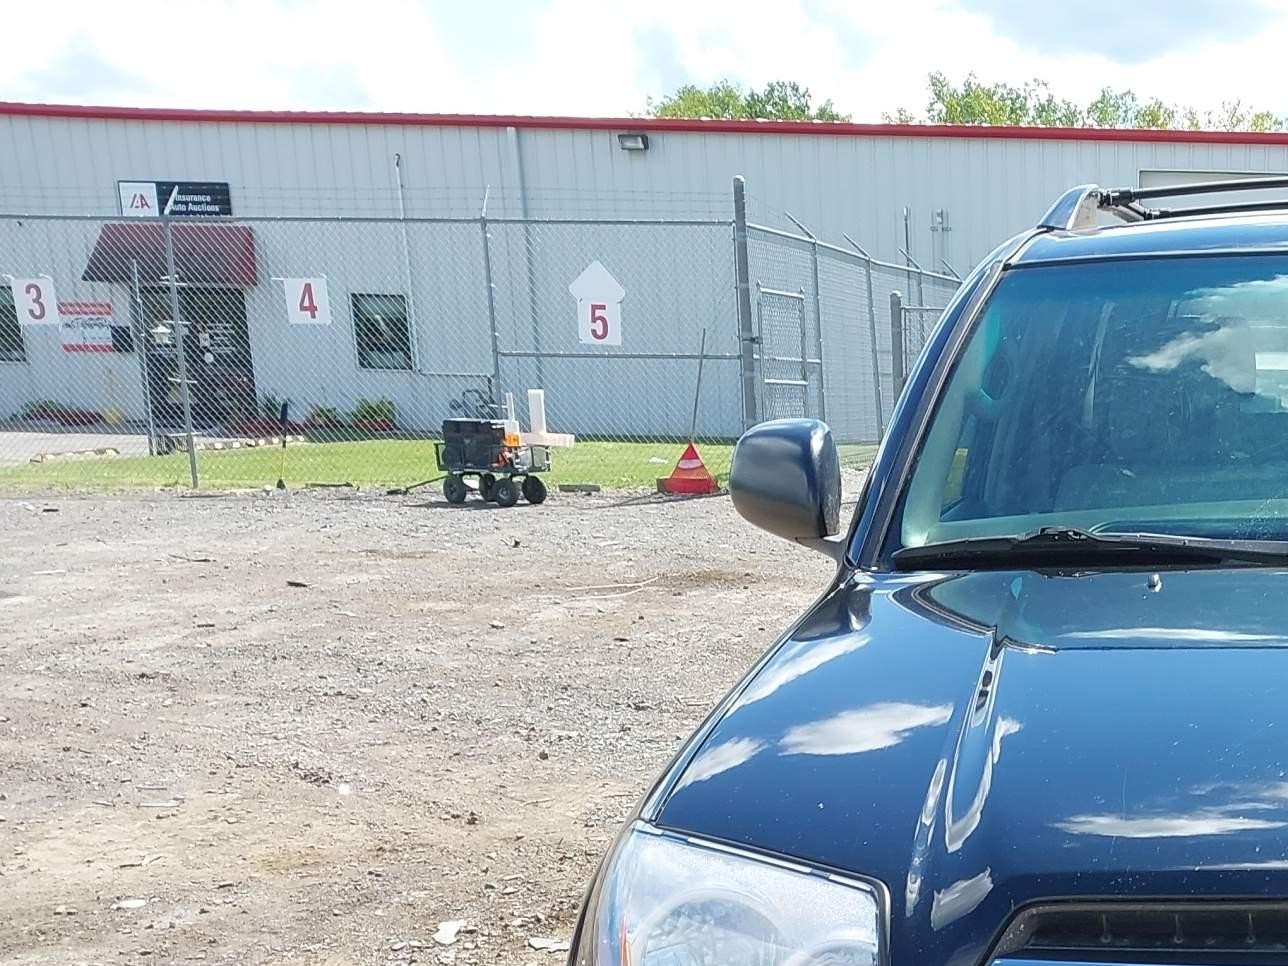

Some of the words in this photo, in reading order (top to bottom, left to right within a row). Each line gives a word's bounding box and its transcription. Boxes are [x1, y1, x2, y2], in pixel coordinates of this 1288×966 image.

[188, 202, 220, 212] Auctions
[25, 283, 46, 320] 3
[299, 282, 319, 319] 4
[590, 304, 609, 340] 5
